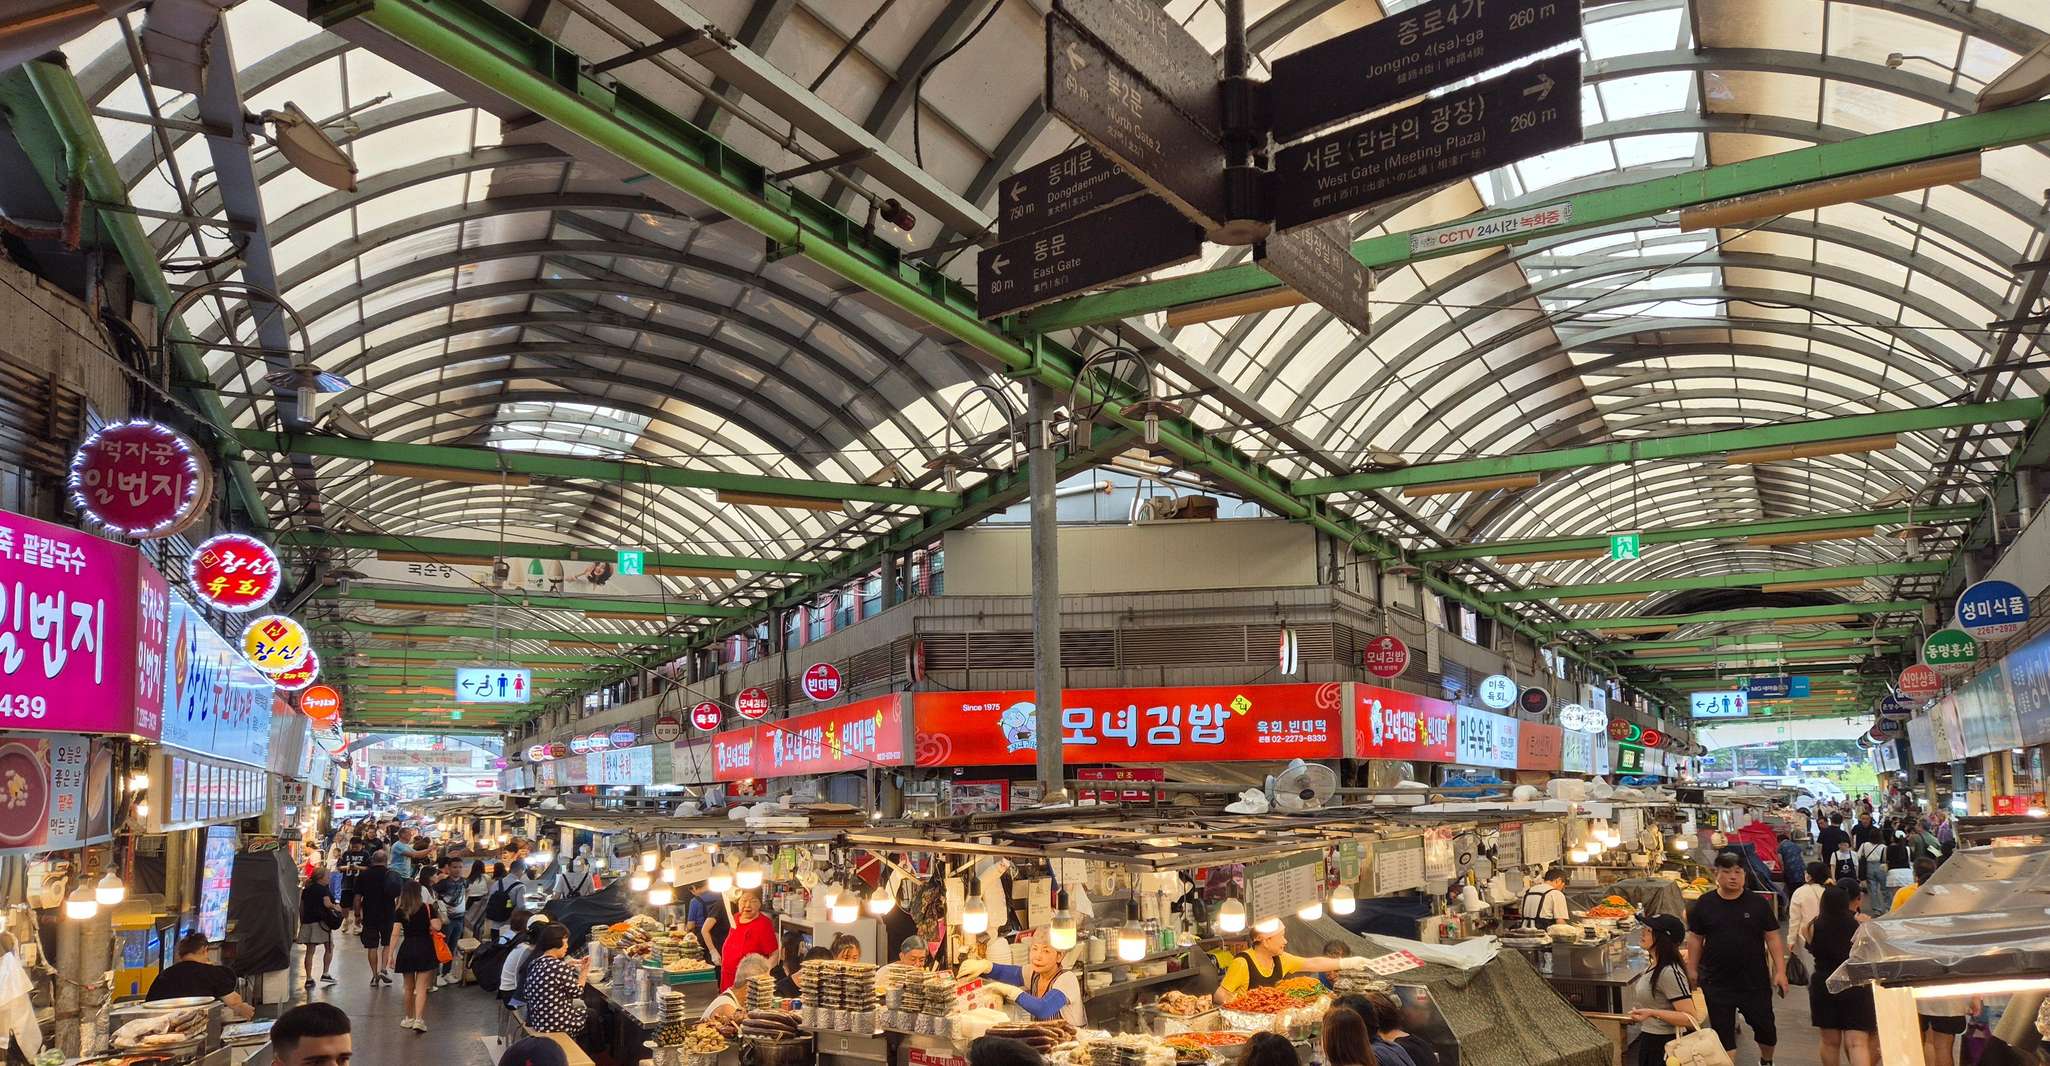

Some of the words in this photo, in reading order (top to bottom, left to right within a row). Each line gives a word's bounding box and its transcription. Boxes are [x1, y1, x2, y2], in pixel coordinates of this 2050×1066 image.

[1398, 0, 1485, 45] 종로4가
[1508, 7, 1535, 31] 260
[1540, 4, 1556, 17] m
[1366, 52, 1420, 79] Jongno
[1424, 29, 1485, 57] 4(sa)-ga
[1108, 70, 1143, 118] 북2문
[1107, 104, 1132, 133] North
[1134, 125, 1154, 148] Gate
[1303, 144, 1341, 172] 서문
[1349, 119, 1420, 161] (만남의
[1430, 95, 1486, 134] 광장)
[1510, 113, 1537, 133] 260
[1541, 108, 1557, 121] m
[1047, 151, 1094, 186] 동대문
[1317, 175, 1348, 190] West
[1351, 162, 1380, 180] Gate
[1384, 143, 1442, 172] (Meeting
[1446, 128, 1486, 151] Plaza)
[1047, 171, 1110, 203] Dongdaemun
[1009, 206, 1025, 221] 750
[1025, 202, 1035, 214] m
[1439, 228, 1475, 245] CCTV
[1477, 218, 1519, 237] 24시간
[1519, 209, 1561, 228] 녹화중
[1034, 233, 1067, 262] 동문
[1033, 266, 1055, 280] East
[1057, 256, 1082, 273] Gate
[991, 280, 1002, 294] 80
[1003, 278, 1014, 289] m
[85, 468, 183, 508] 일번지
[219, 550, 274, 575] 창신
[407, 562, 453, 579] 국순당
[207, 576, 261, 598] 육회
[1961, 596, 2025, 621] 성미식품
[0, 581, 105, 685] 일번지
[253, 641, 300, 661] 창신
[1367, 650, 1406, 663] 모녀김밥
[1926, 641, 1975, 659] 동명홍삼
[138, 640, 162, 703] 일번지
[1902, 671, 1938, 689] 신안상회
[807, 678, 838, 692] 빈대떡
[1488, 680, 1506, 690] 미옥
[0, 694, 47, 719] 439
[739, 698, 768, 709] 모녀김밥
[962, 703, 983, 712] Since
[983, 703, 1001, 711] 1975
[696, 713, 718, 724] 육회
[1062, 703, 1232, 748] 모녀김밥
[1385, 708, 1417, 743] 모녀김밥
[1428, 716, 1448, 748] 빈대떡
[785, 725, 823, 761] 모녀김밥
[842, 716, 876, 756] 빈대떡
[1460, 715, 1493, 760] 미옥육회
[57, 746, 81, 765] 오늘은
[726, 742, 751, 769] 모녀김밥
